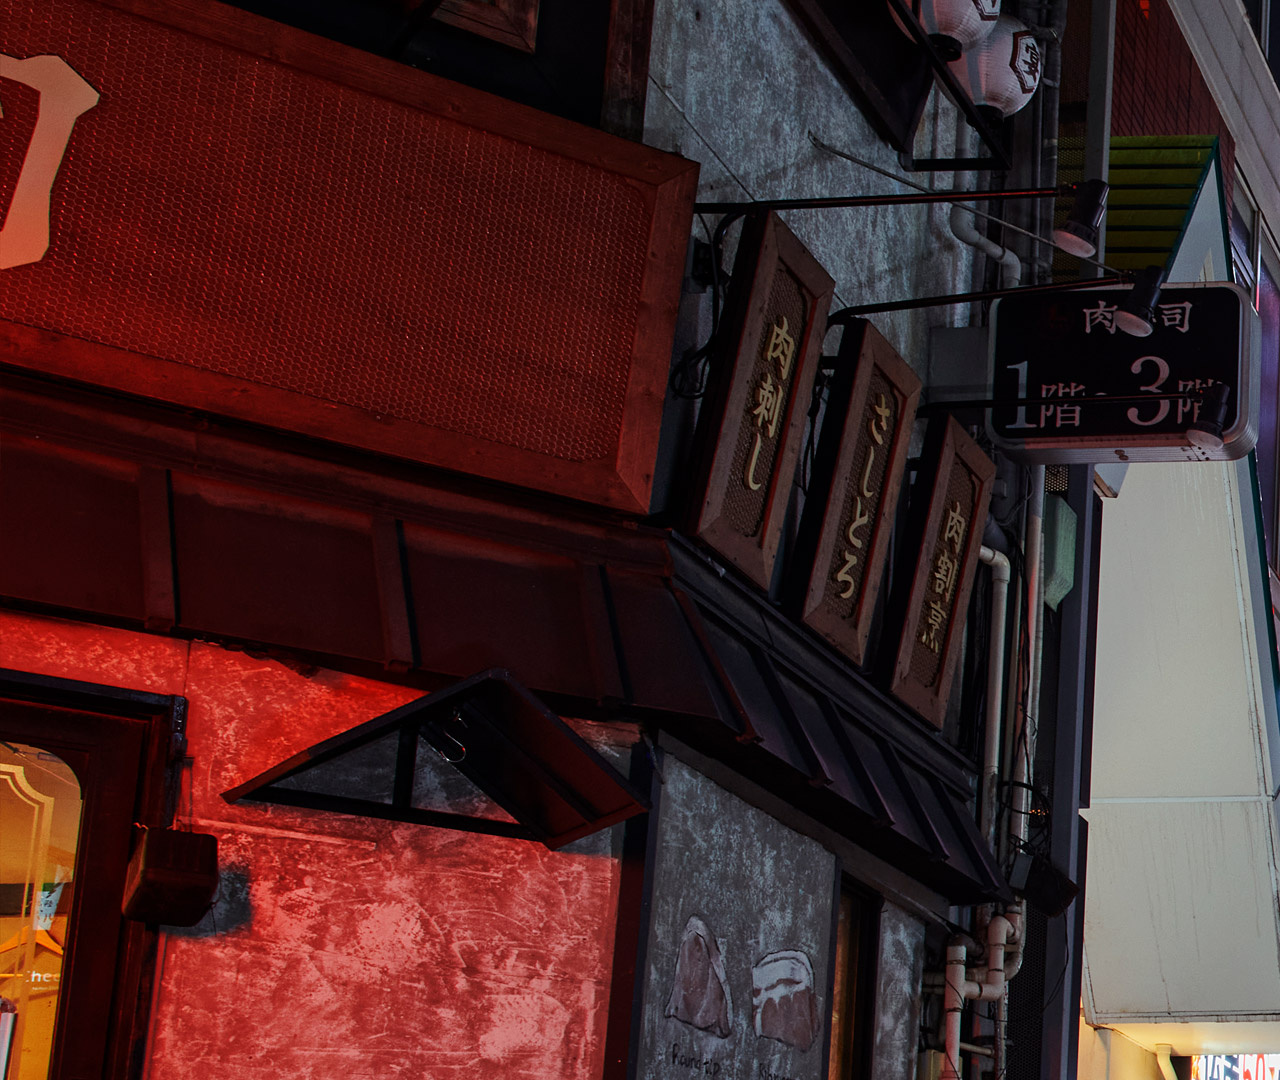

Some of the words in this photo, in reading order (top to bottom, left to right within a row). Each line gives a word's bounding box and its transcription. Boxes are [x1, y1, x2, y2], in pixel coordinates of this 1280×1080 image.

[747, 316, 795, 491] 肉刺し
[1082, 300, 1194, 335] 肉司
[836, 392, 891, 600] さしとろ
